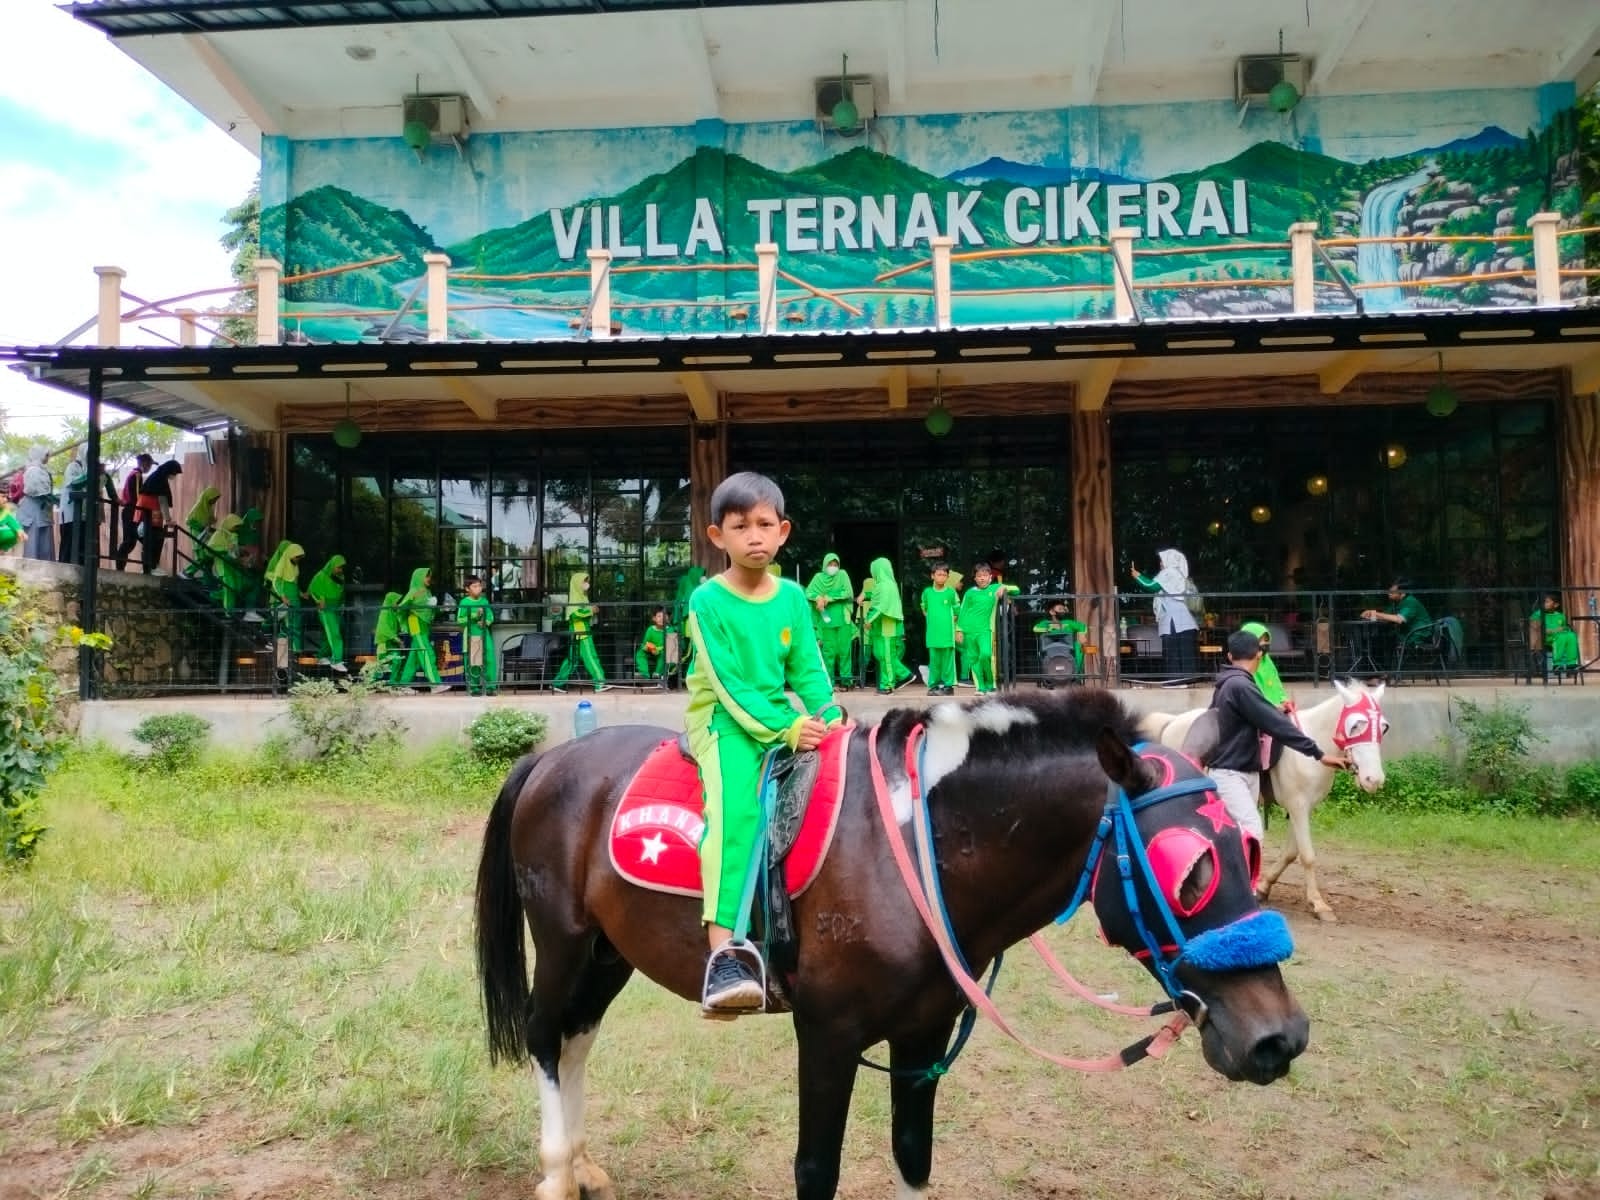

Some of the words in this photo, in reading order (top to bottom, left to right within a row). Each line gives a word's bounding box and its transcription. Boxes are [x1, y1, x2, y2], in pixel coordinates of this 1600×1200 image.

[550, 197, 724, 260] VILLA
[747, 190, 985, 252] TERNAK
[1003, 179, 1249, 244] CIKERAI
